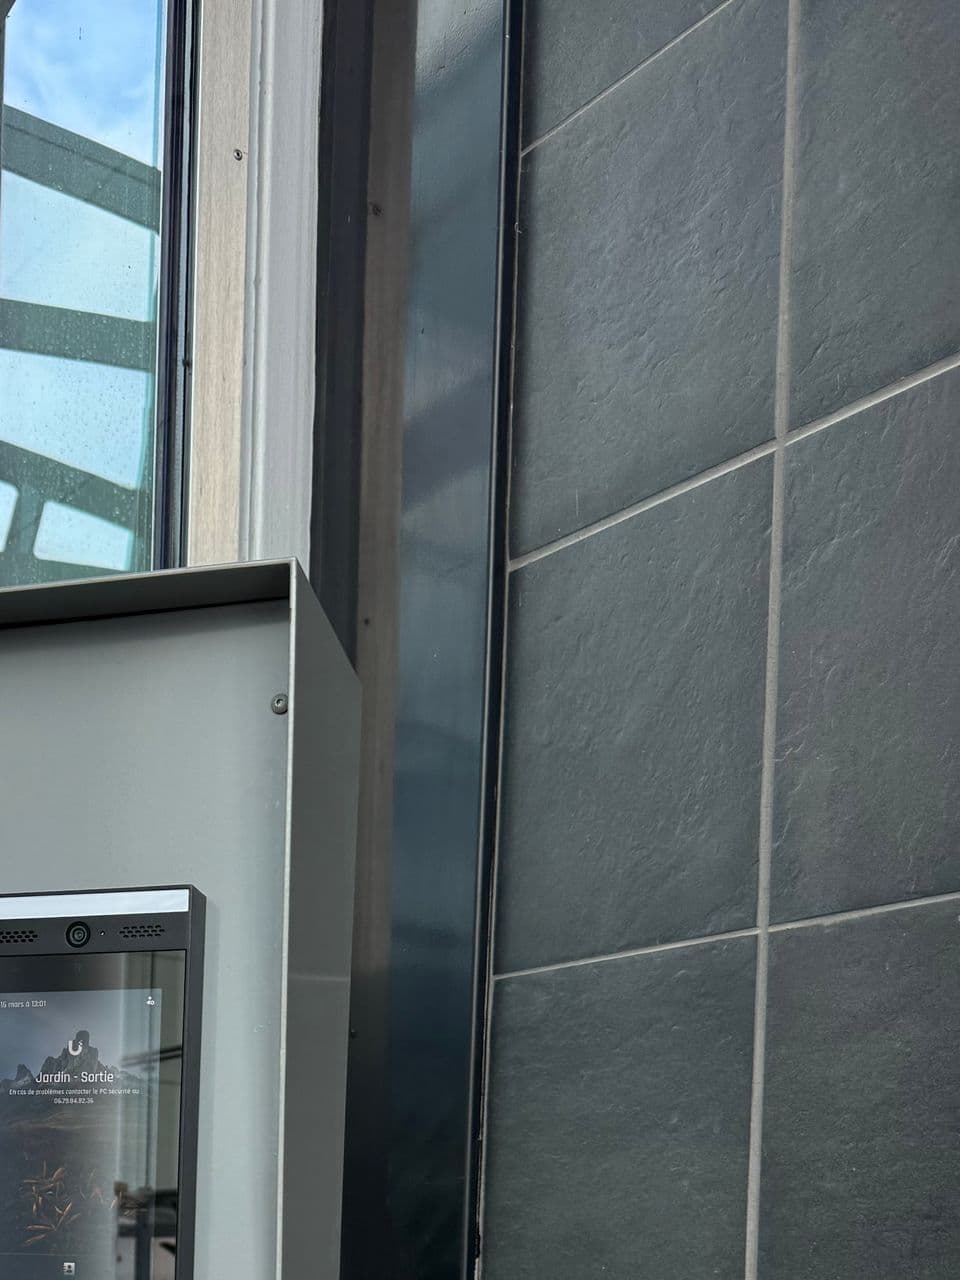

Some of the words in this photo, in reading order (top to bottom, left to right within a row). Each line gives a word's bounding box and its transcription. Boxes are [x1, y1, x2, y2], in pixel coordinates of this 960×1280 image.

[35, 1071, 70, 1083] Jardin
[80, 1071, 114, 1083] Sortie
[8, 1088, 17, 1096] En
[27, 1088, 35, 1096] de
